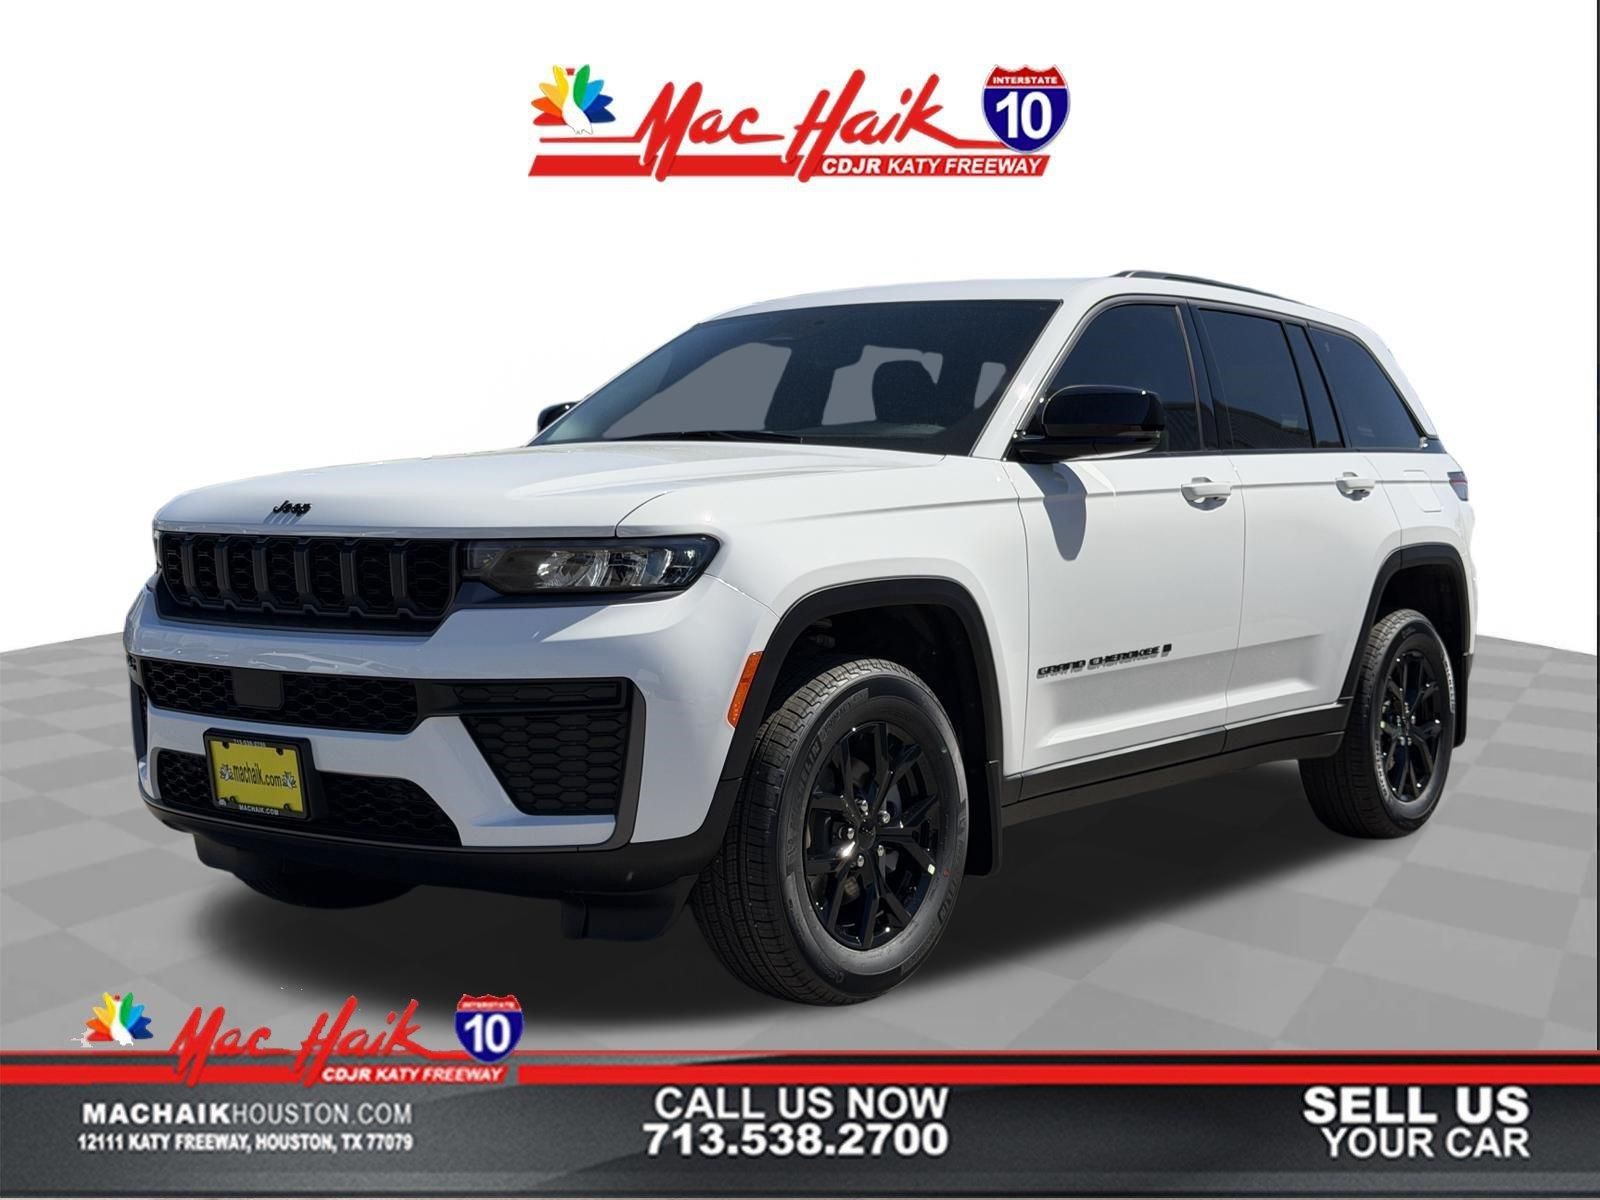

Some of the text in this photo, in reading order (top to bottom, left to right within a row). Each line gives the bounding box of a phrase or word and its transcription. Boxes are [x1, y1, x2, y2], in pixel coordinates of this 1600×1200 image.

[273, 500, 311, 517] Jeep
[1037, 645, 1160, 676] GRAND CHEROKEE
[232, 762, 282, 787] machaik.com
